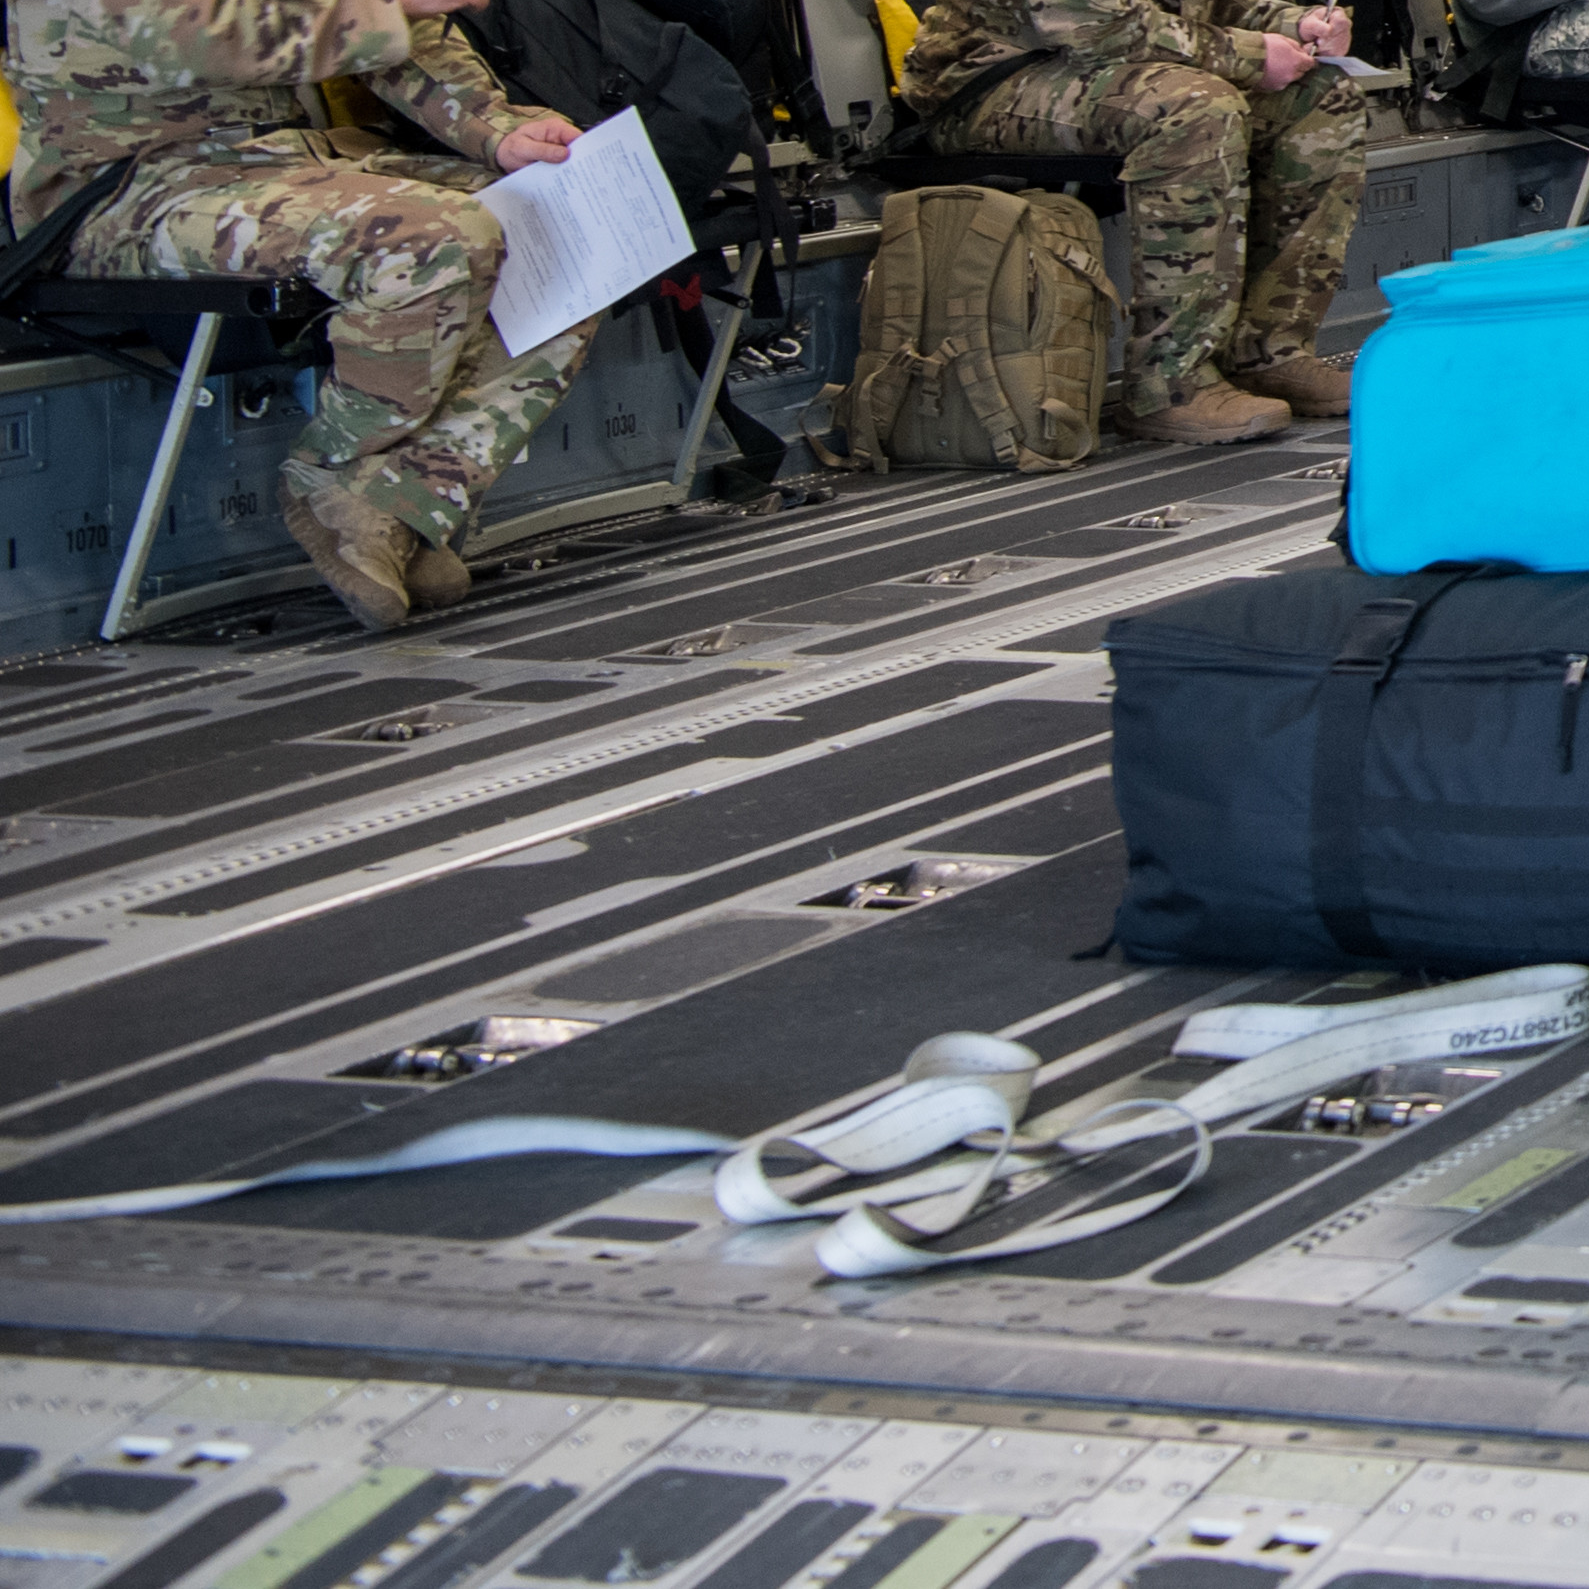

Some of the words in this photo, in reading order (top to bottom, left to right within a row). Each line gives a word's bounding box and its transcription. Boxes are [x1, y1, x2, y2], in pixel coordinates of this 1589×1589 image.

[605, 413, 636, 438] 1030
[219, 492, 257, 519] 1060
[66, 524, 108, 553] 1070
[1451, 1011, 1589, 1049] C12687C240
